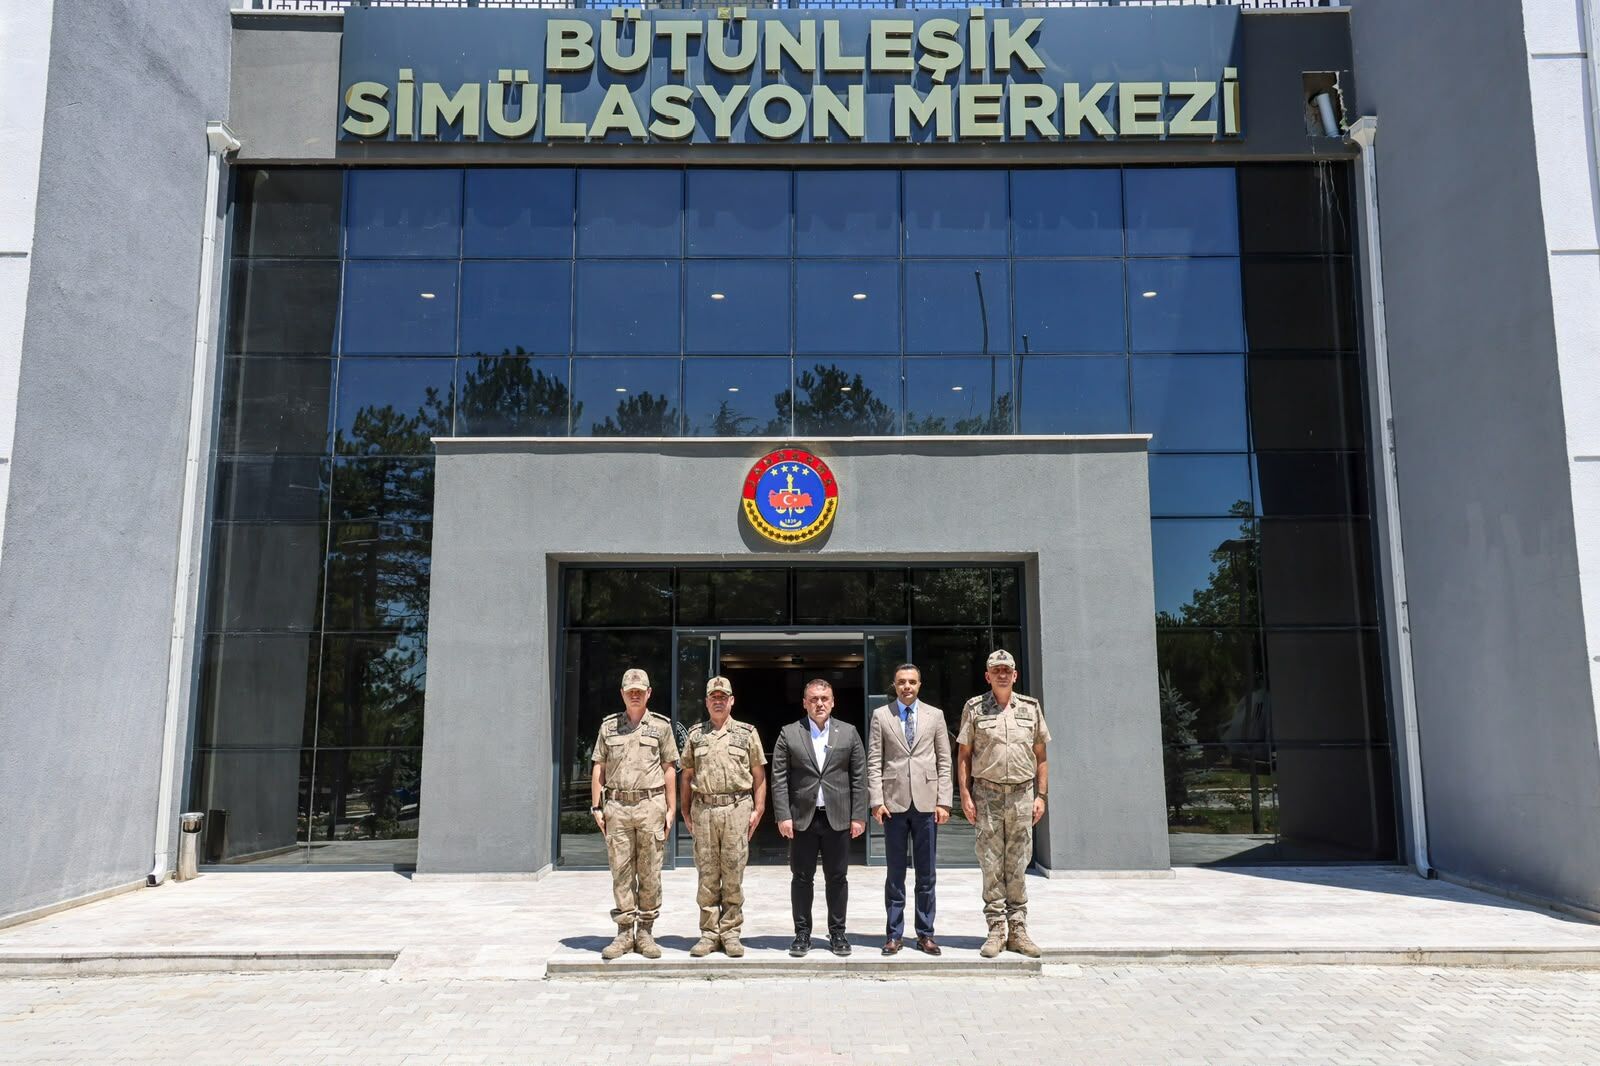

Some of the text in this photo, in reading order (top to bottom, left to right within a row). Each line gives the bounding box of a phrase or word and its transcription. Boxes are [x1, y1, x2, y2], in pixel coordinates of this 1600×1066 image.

[545, 7, 1046, 83] BÜTÜNLEŞİK
[342, 67, 1240, 139] SİMÜLASYON MERKEZİ
